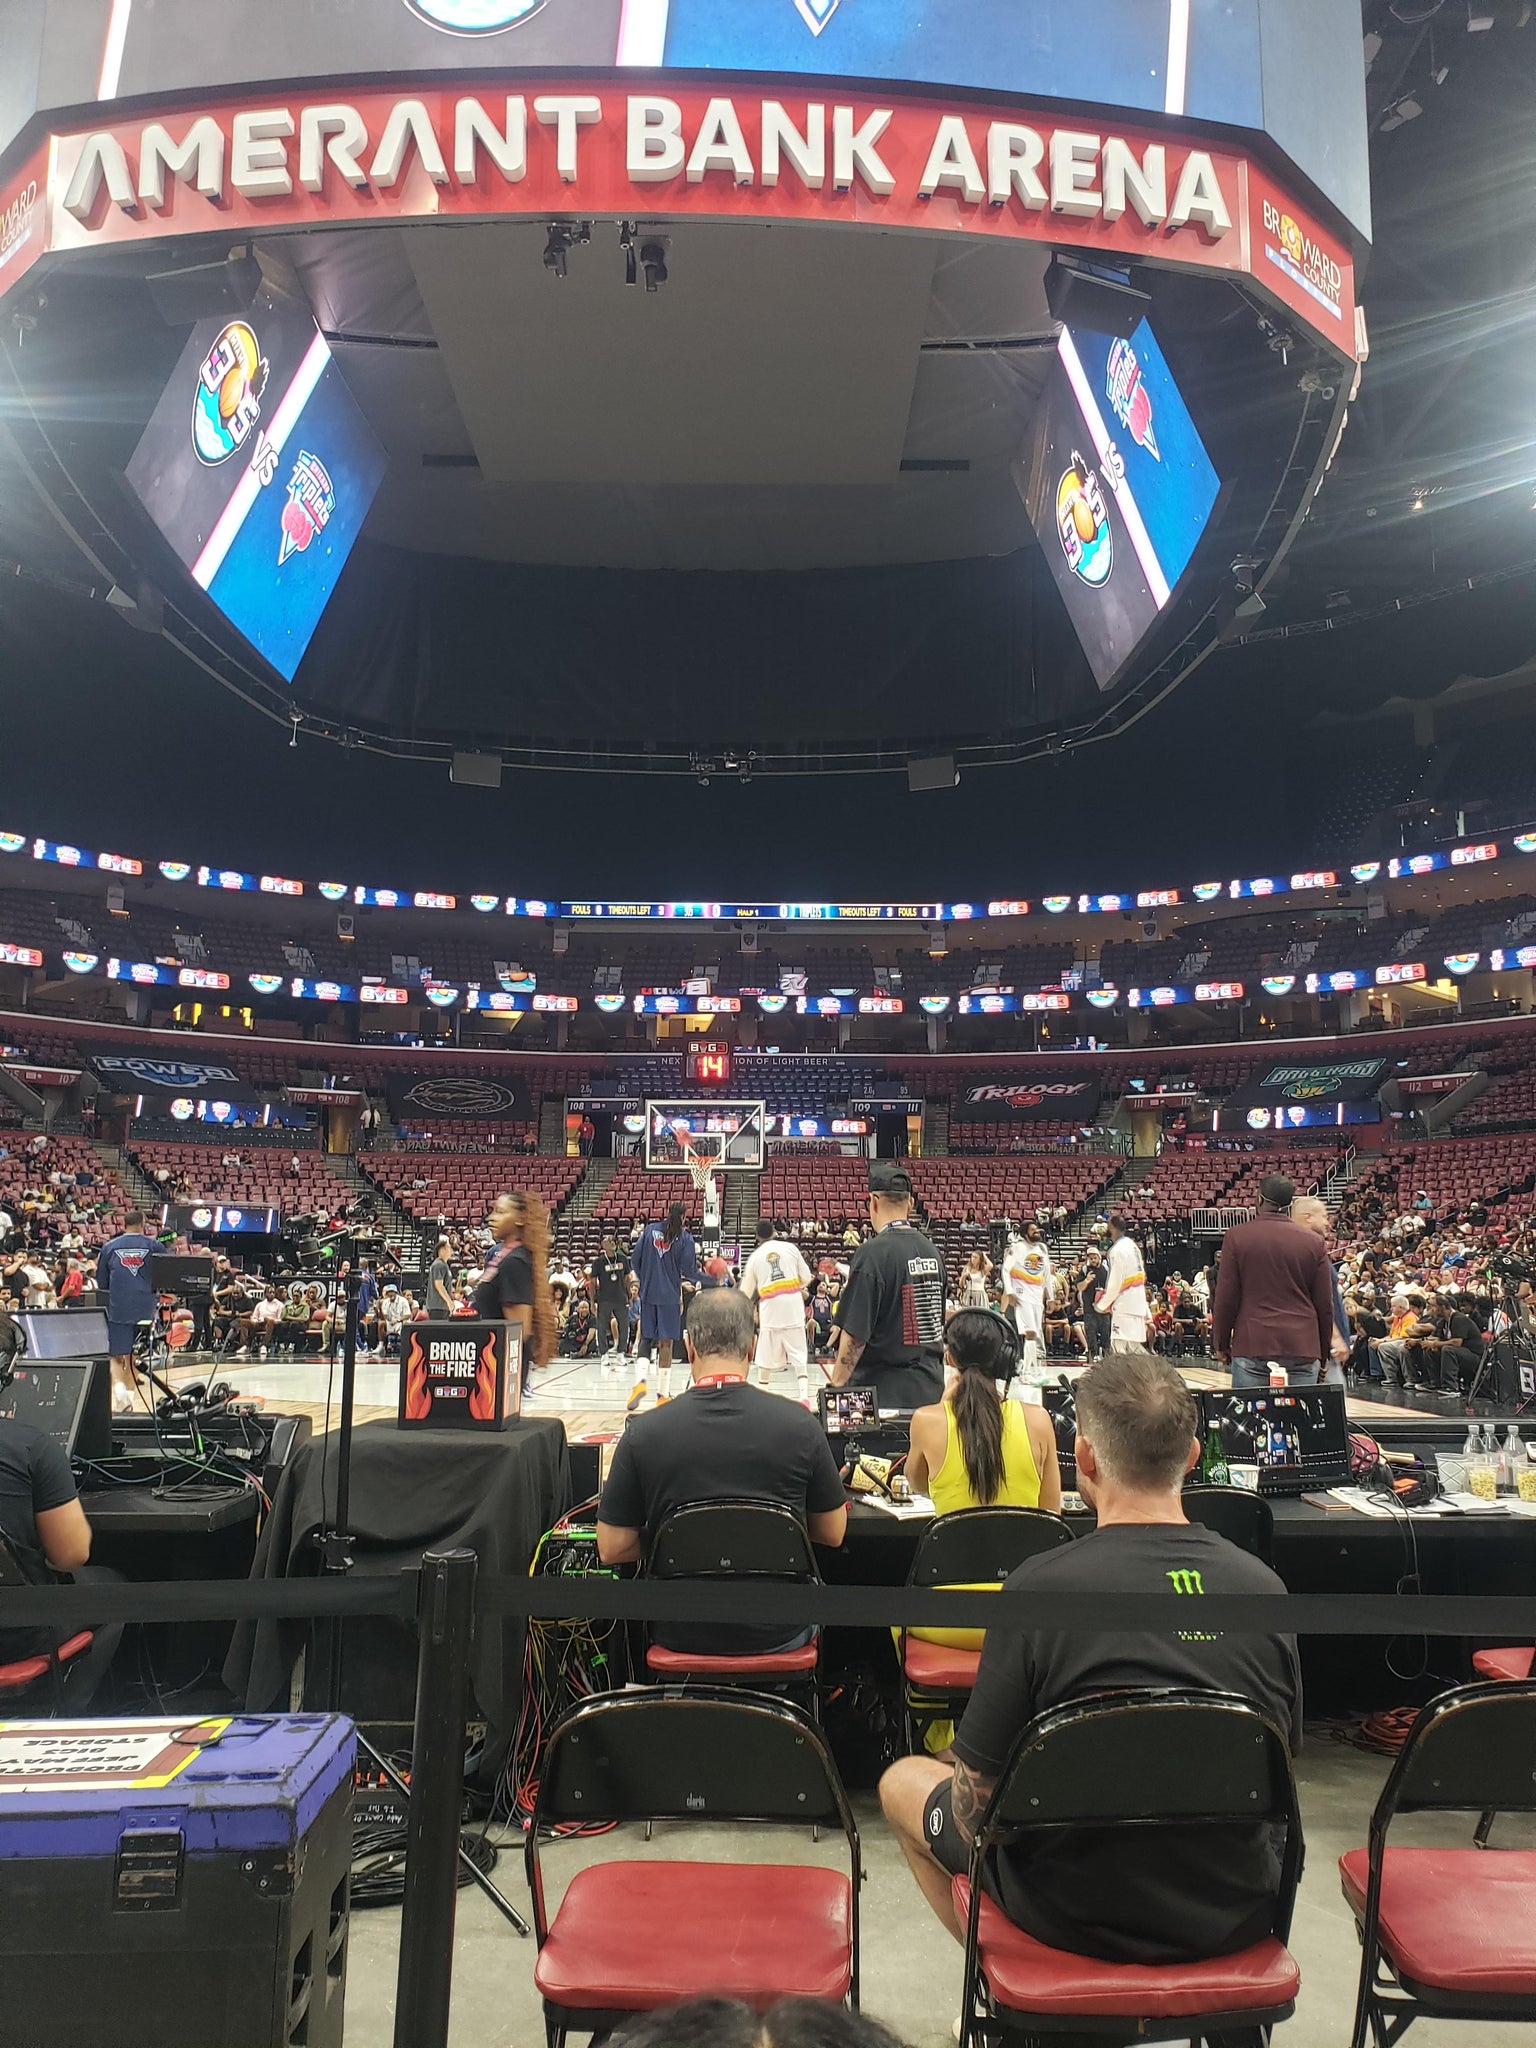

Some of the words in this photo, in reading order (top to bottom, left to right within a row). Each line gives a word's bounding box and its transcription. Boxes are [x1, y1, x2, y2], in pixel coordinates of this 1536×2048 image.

[62, 95, 601, 218] AMERANT
[627, 96, 895, 195] BANK
[917, 115, 1232, 240] ARENA
[1303, 262, 1341, 304] COUNTY
[251, 430, 279, 486] VS
[1100, 441, 1125, 492] VS
[571, 905, 591, 915] FOULS
[609, 905, 636, 915] TIMEOUTS
[637, 905, 651, 915] LEFT
[838, 906, 866, 917] TIMEOUTS
[867, 906, 881, 917] LEFT
[898, 906, 917, 917] FOULS
[661, 1057, 682, 1065] NEX
[703, 1055, 723, 1078] 14
[756, 1057, 768, 1065] OF
[772, 1057, 800, 1066] LIGHT
[803, 1058, 828, 1066] BEER
[102, 1059, 225, 1078] POWER
[59, 1074, 76, 1084] 107
[970, 1083, 1083, 1102] TRILOGY
[1408, 1082, 1421, 1092] 112
[294, 1092, 308, 1102] 107
[335, 1095, 350, 1104] 108
[570, 1102, 585, 1110] 108
[623, 1102, 637, 1110] 109
[854, 1103, 870, 1112] 109
[907, 1103, 919, 1112] 111
[429, 1341, 477, 1361] BRING
[429, 1363, 446, 1375] THE
[446, 1361, 476, 1378] FIRE
[0, 1757, 69, 1765] MAY
[71, 1755, 139, 1764] JEFF
